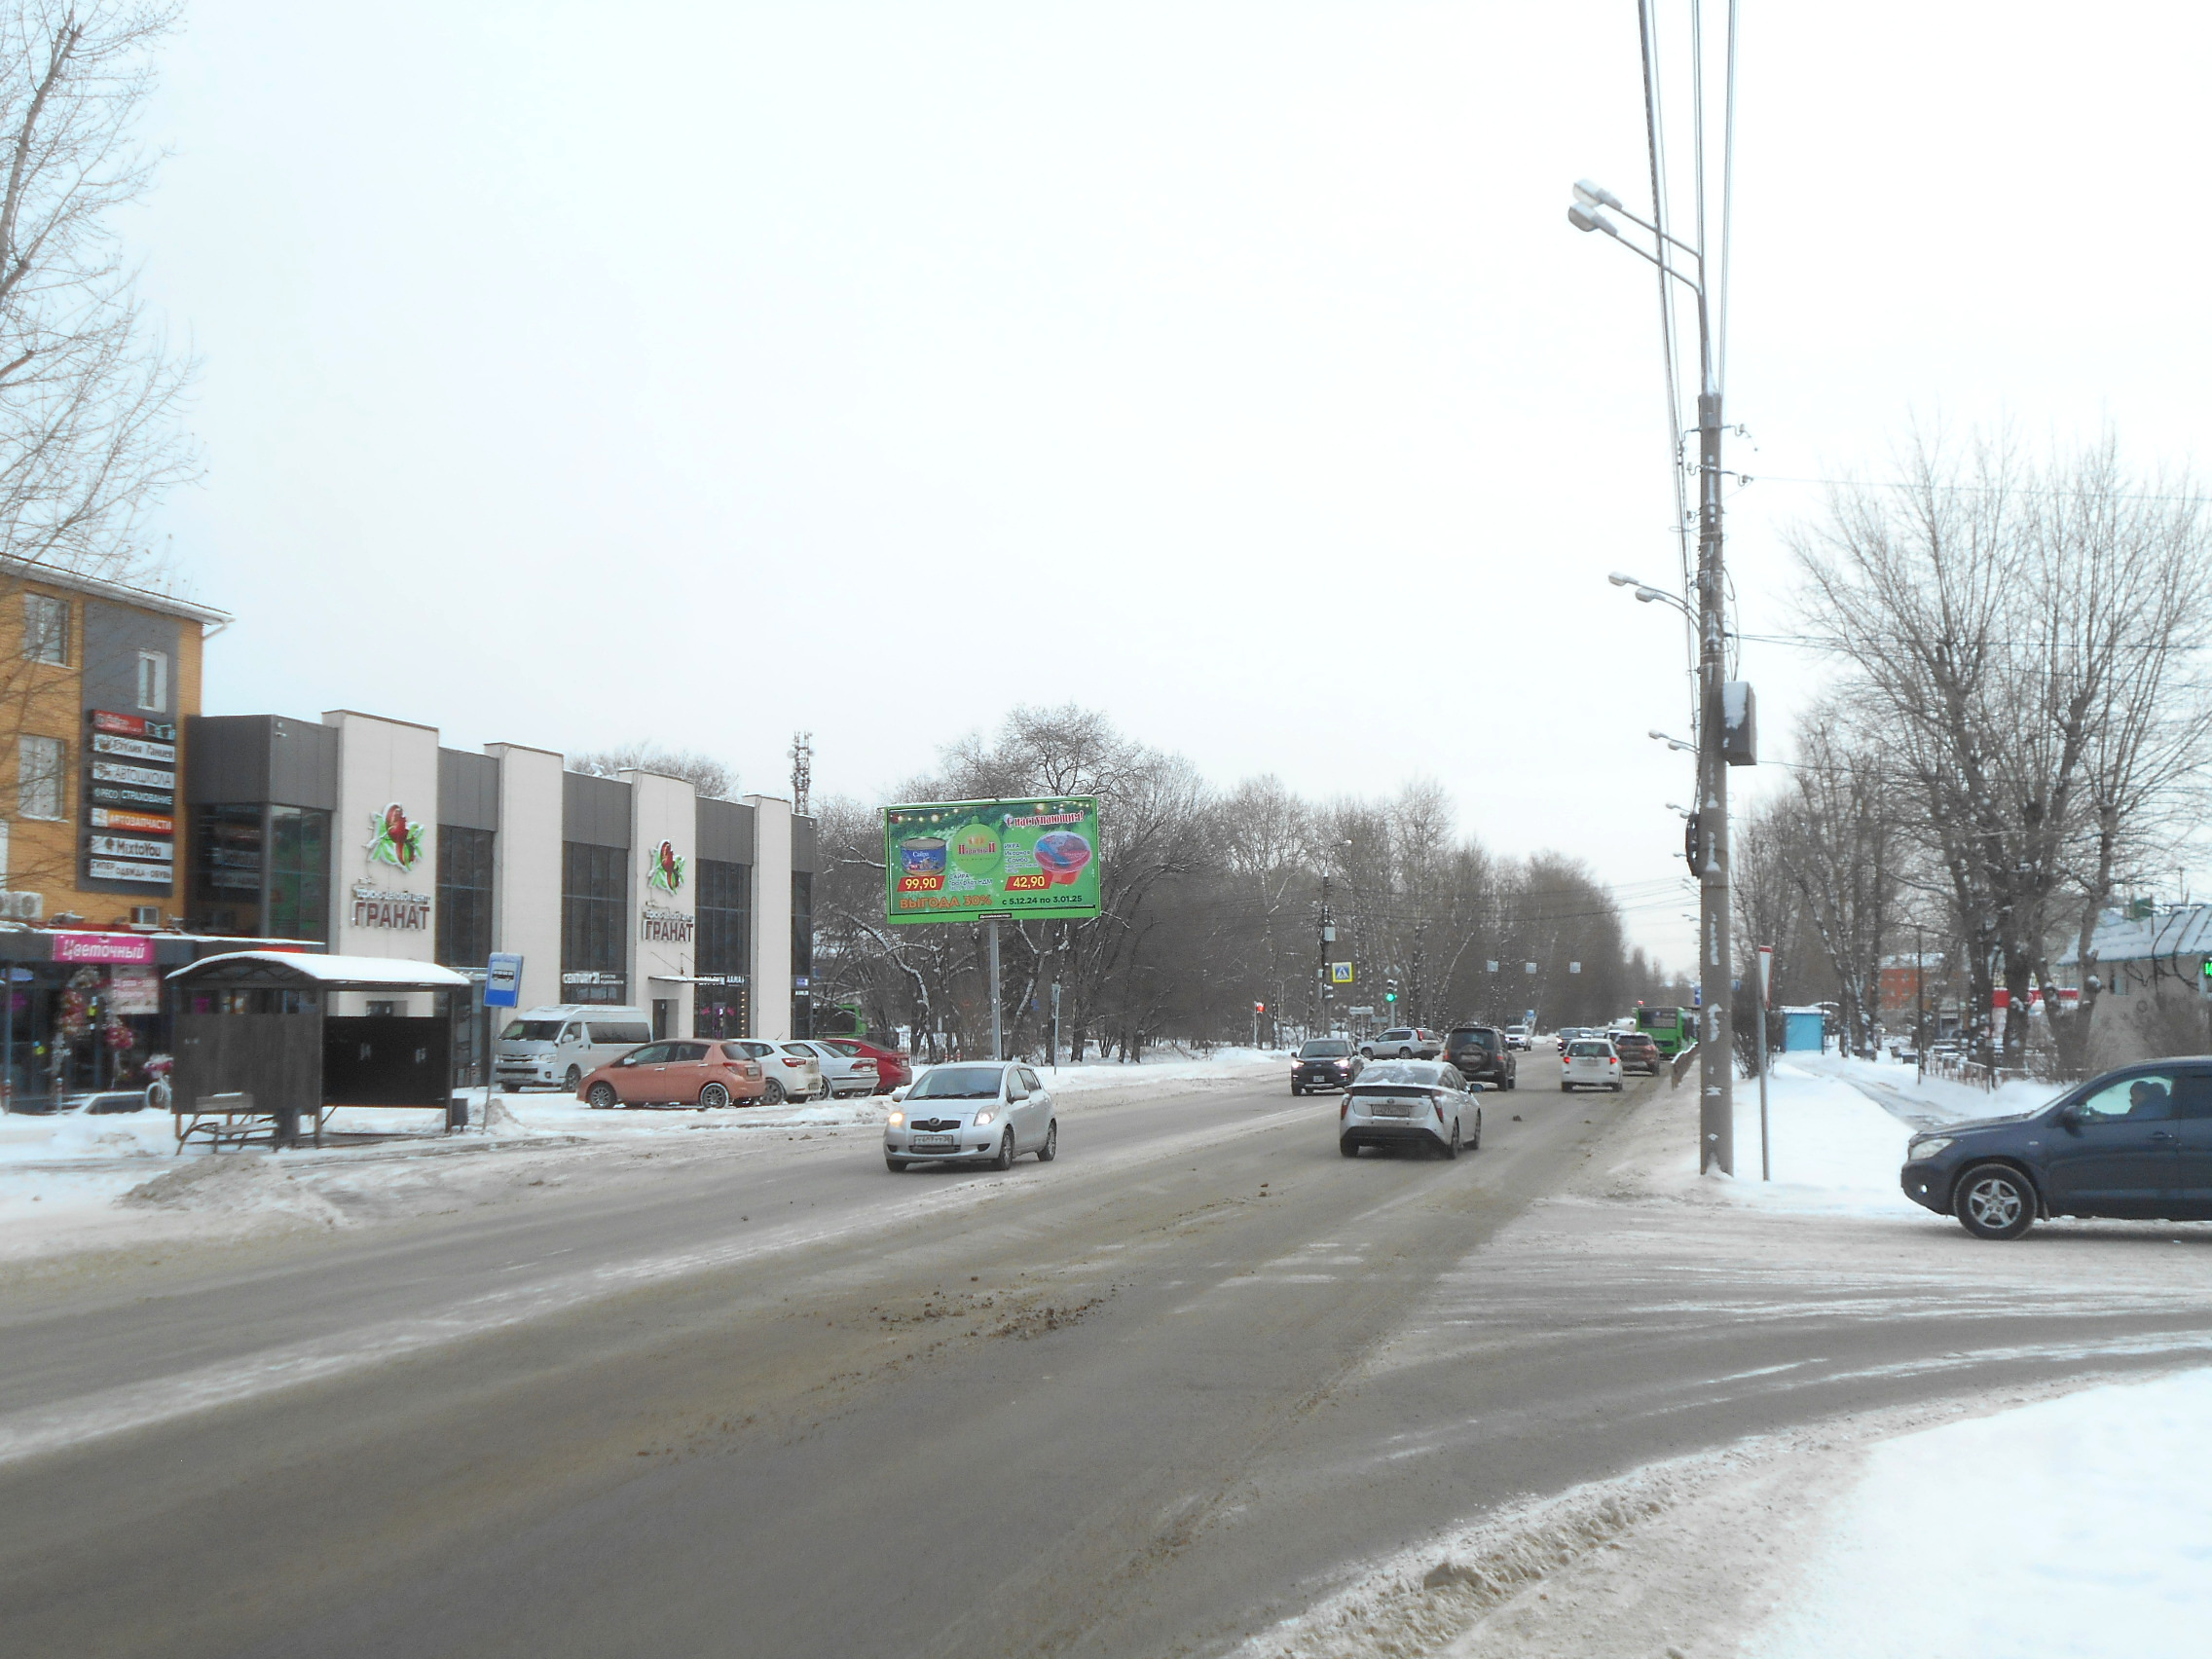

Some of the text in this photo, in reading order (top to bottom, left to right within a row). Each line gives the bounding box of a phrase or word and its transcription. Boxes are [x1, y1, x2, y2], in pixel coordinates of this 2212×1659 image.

[116, 766, 172, 785] АВТОШКОЛА
[122, 791, 172, 805] СТРАХОВАНИЕ
[109, 814, 172, 830] АВТОЗАПЧАСТИ
[1014, 810, 1084, 828] наступающим!
[117, 839, 162, 857] MixtoYou
[117, 866, 171, 879] ОДЕЖДА ОБУВЬ
[904, 877, 937, 890] 99,90
[1013, 876, 1045, 889] 42,90
[900, 895, 993, 909] ВЫГОДА 30%
[1010, 897, 1037, 905] 5.12.24
[1053, 895, 1083, 903] 3.01.25
[353, 902, 430, 930] ГРАНАТ
[645, 920, 694, 942] ГРАНАТ
[62, 939, 146, 961] Цветочный
[562, 973, 592, 984] CENTURY
